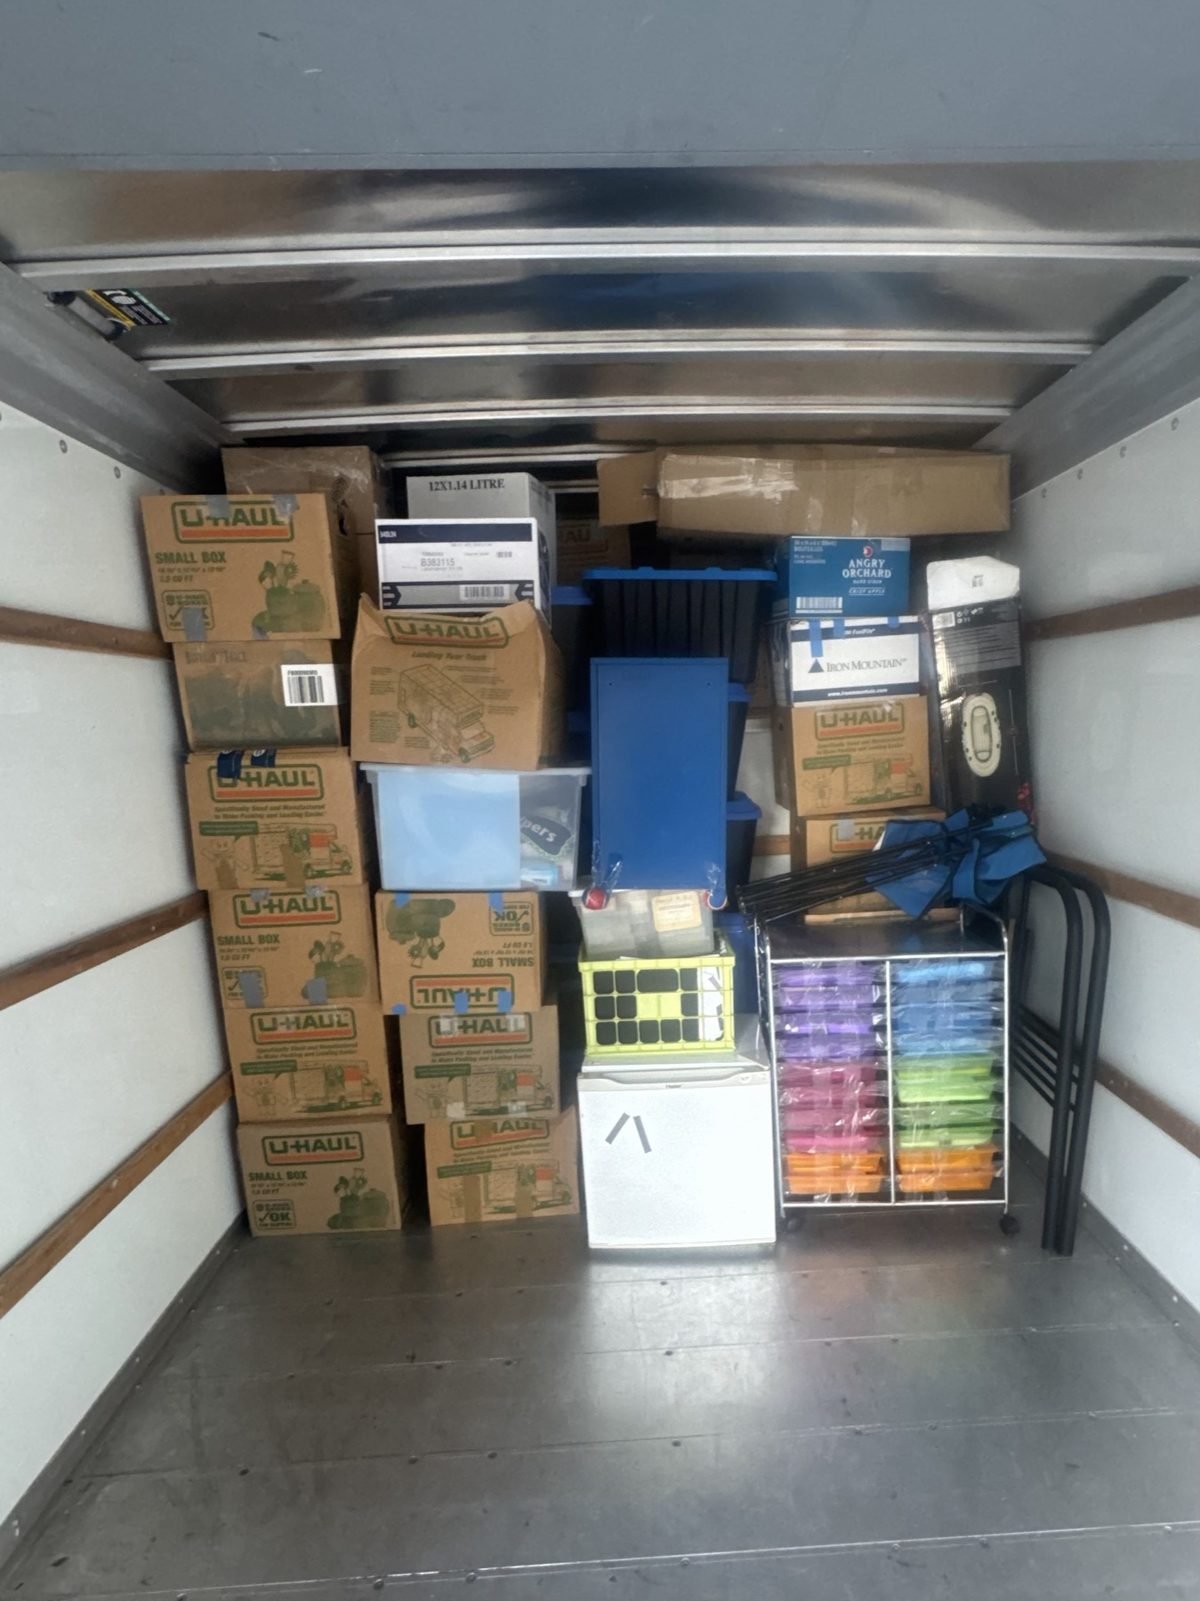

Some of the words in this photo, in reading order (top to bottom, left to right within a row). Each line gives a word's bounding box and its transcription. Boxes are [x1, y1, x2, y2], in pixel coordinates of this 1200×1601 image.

[470, 478, 505, 490] LITRE
[155, 551, 198, 564] SMALL
[201, 550, 227, 564] BOX
[848, 559, 886, 569] ANGRY
[841, 569, 892, 579] ORCHARD
[393, 622, 500, 639] U-HAUL
[826, 661, 851, 673] IRON
[851, 658, 903, 671] MOUNTAIN
[820, 709, 899, 728] U-HAUL
[240, 896, 334, 915] U-HAUL
[217, 935, 255, 946] SMALL
[258, 934, 281, 945] BOX
[472, 958, 495, 968] BOX
[498, 957, 536, 968] SMALL
[257, 1013, 350, 1032] U-HAUL
[457, 1119, 544, 1138] UAUL
[268, 1137, 357, 1154] U-HAUL
[249, 1171, 283, 1182] SMALL
[286, 1170, 308, 1180] BOX
[269, 1212, 292, 1222] OK
